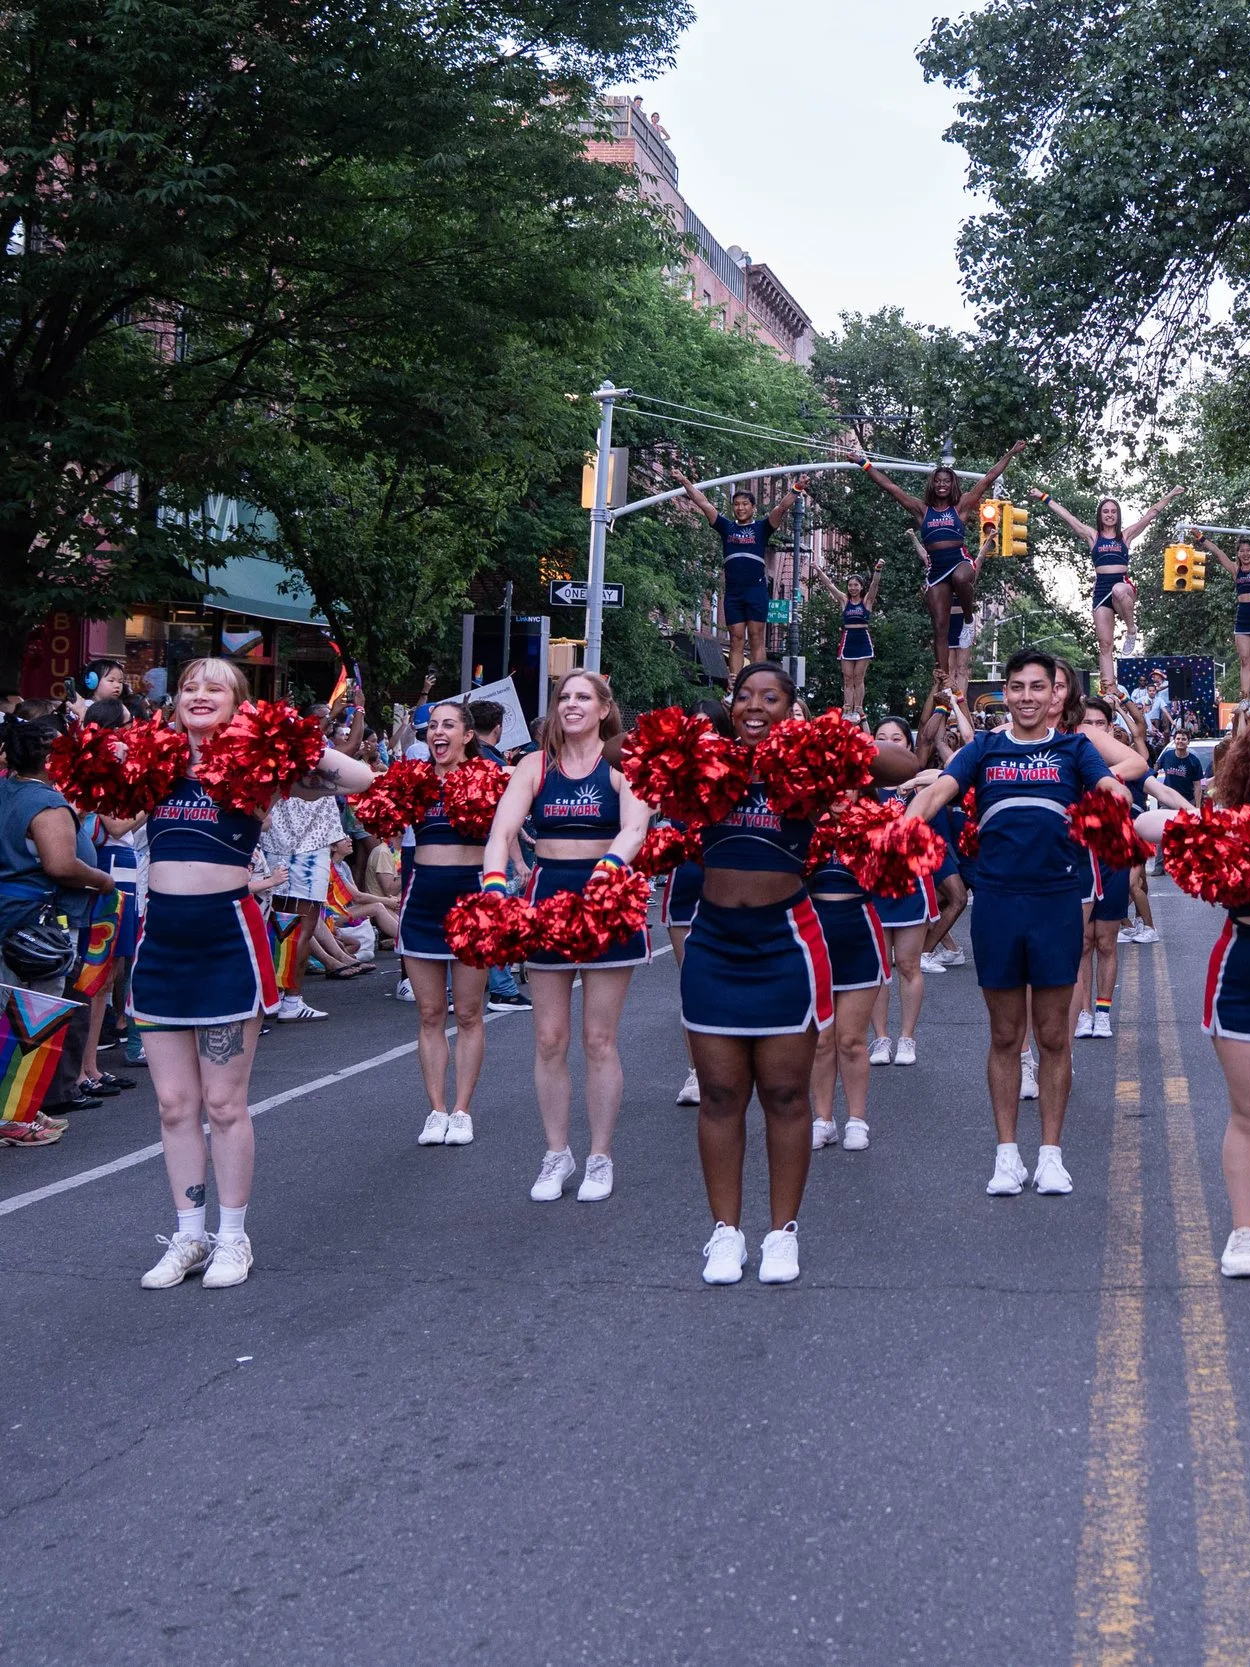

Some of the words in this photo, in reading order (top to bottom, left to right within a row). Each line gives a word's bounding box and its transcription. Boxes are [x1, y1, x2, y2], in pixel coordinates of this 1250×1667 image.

[565, 589, 586, 599] ONE
[602, 590, 613, 599] AY
[1000, 760, 1044, 769] CHEER
[986, 766, 1019, 784] NEW
[1020, 767, 1061, 783] YORK
[168, 799, 207, 807] CHEER
[153, 805, 183, 821] NEW
[183, 807, 219, 824] YORK
[543, 804, 570, 818] NEW
[570, 804, 602, 818] YORK
[737, 806, 768, 814] HEER
[745, 813, 782, 832] YORK
